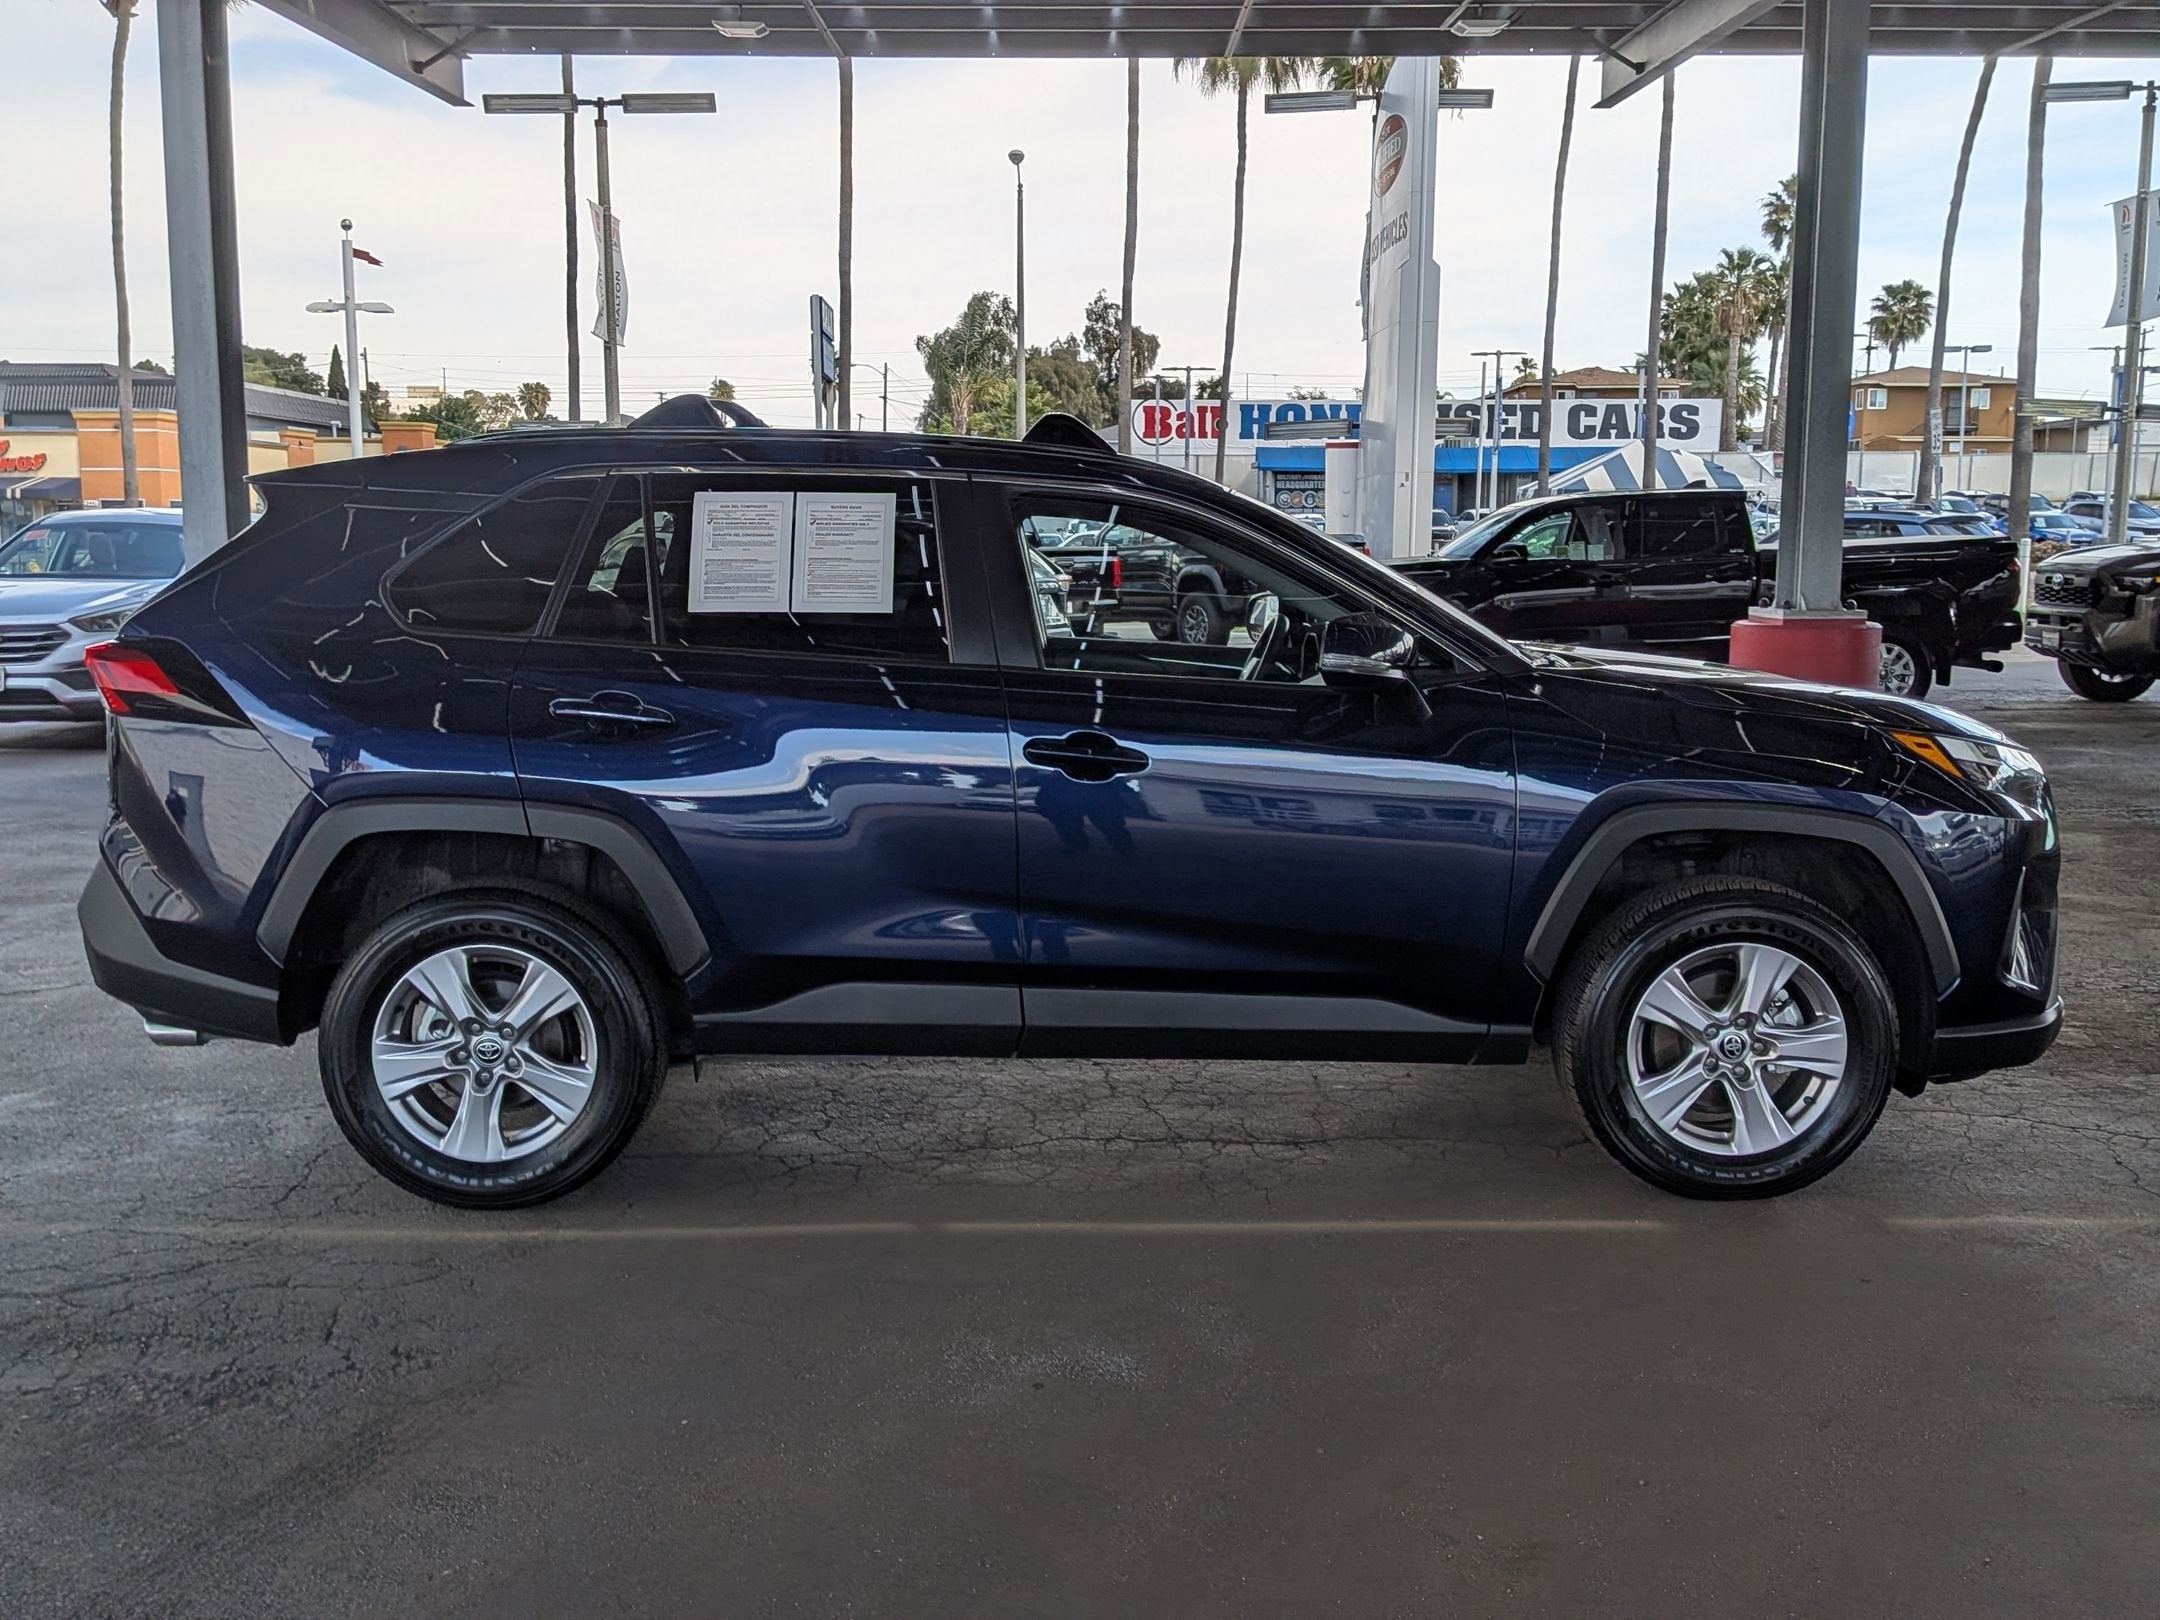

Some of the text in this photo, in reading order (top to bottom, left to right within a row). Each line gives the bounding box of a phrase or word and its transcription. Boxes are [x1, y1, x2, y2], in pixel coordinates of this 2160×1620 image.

[1142, 405, 1223, 439] Ball
[1239, 403, 1362, 439] HON
[1567, 403, 1701, 440] CARS
[1276, 480, 1326, 489] HEADQUARTER
